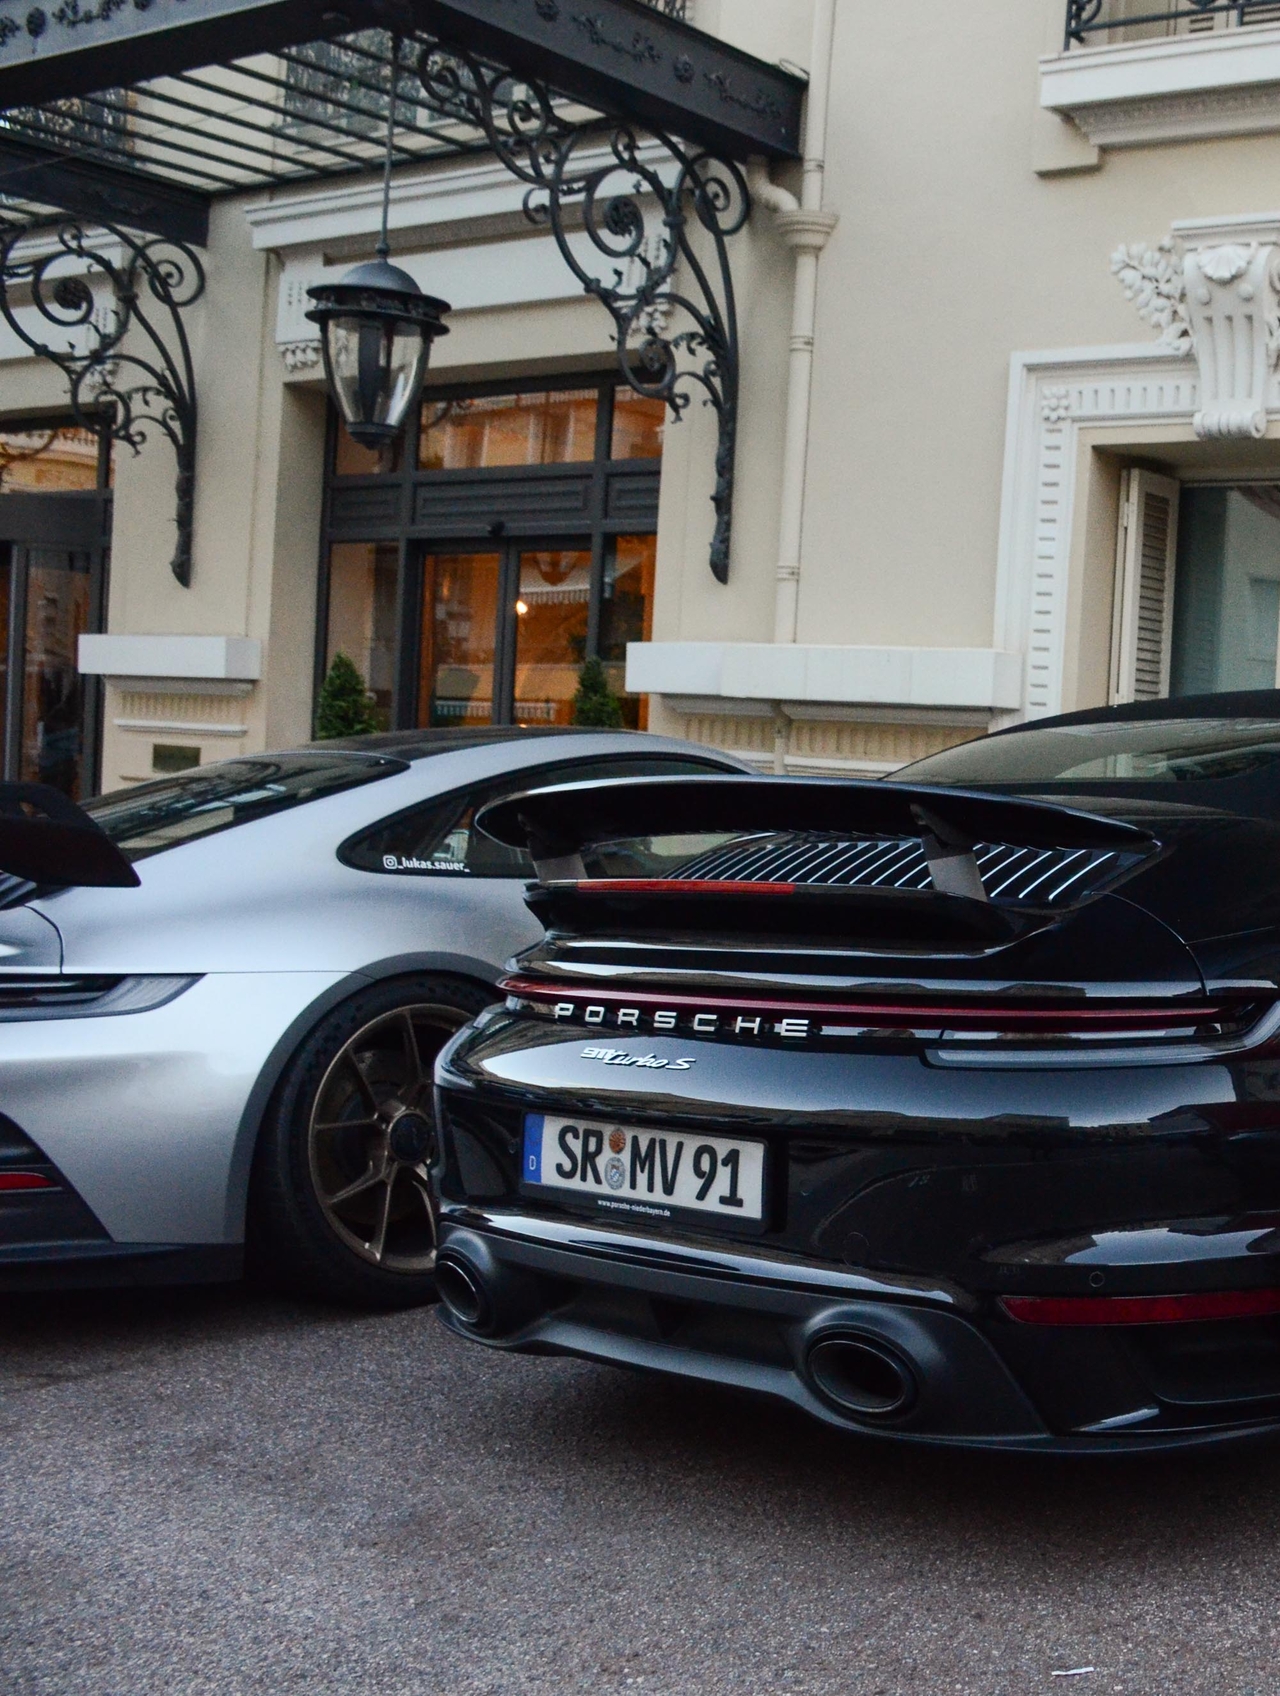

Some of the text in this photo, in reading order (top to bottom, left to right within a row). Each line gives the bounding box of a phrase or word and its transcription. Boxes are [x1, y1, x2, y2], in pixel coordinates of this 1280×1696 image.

[555, 1003, 808, 1037] PORSCHE
[665, 1058, 696, 1069] S
[529, 1155, 537, 1170] D
[555, 1125, 603, 1185] SR
[629, 1135, 684, 1196] MV
[693, 1144, 744, 1207] 91
